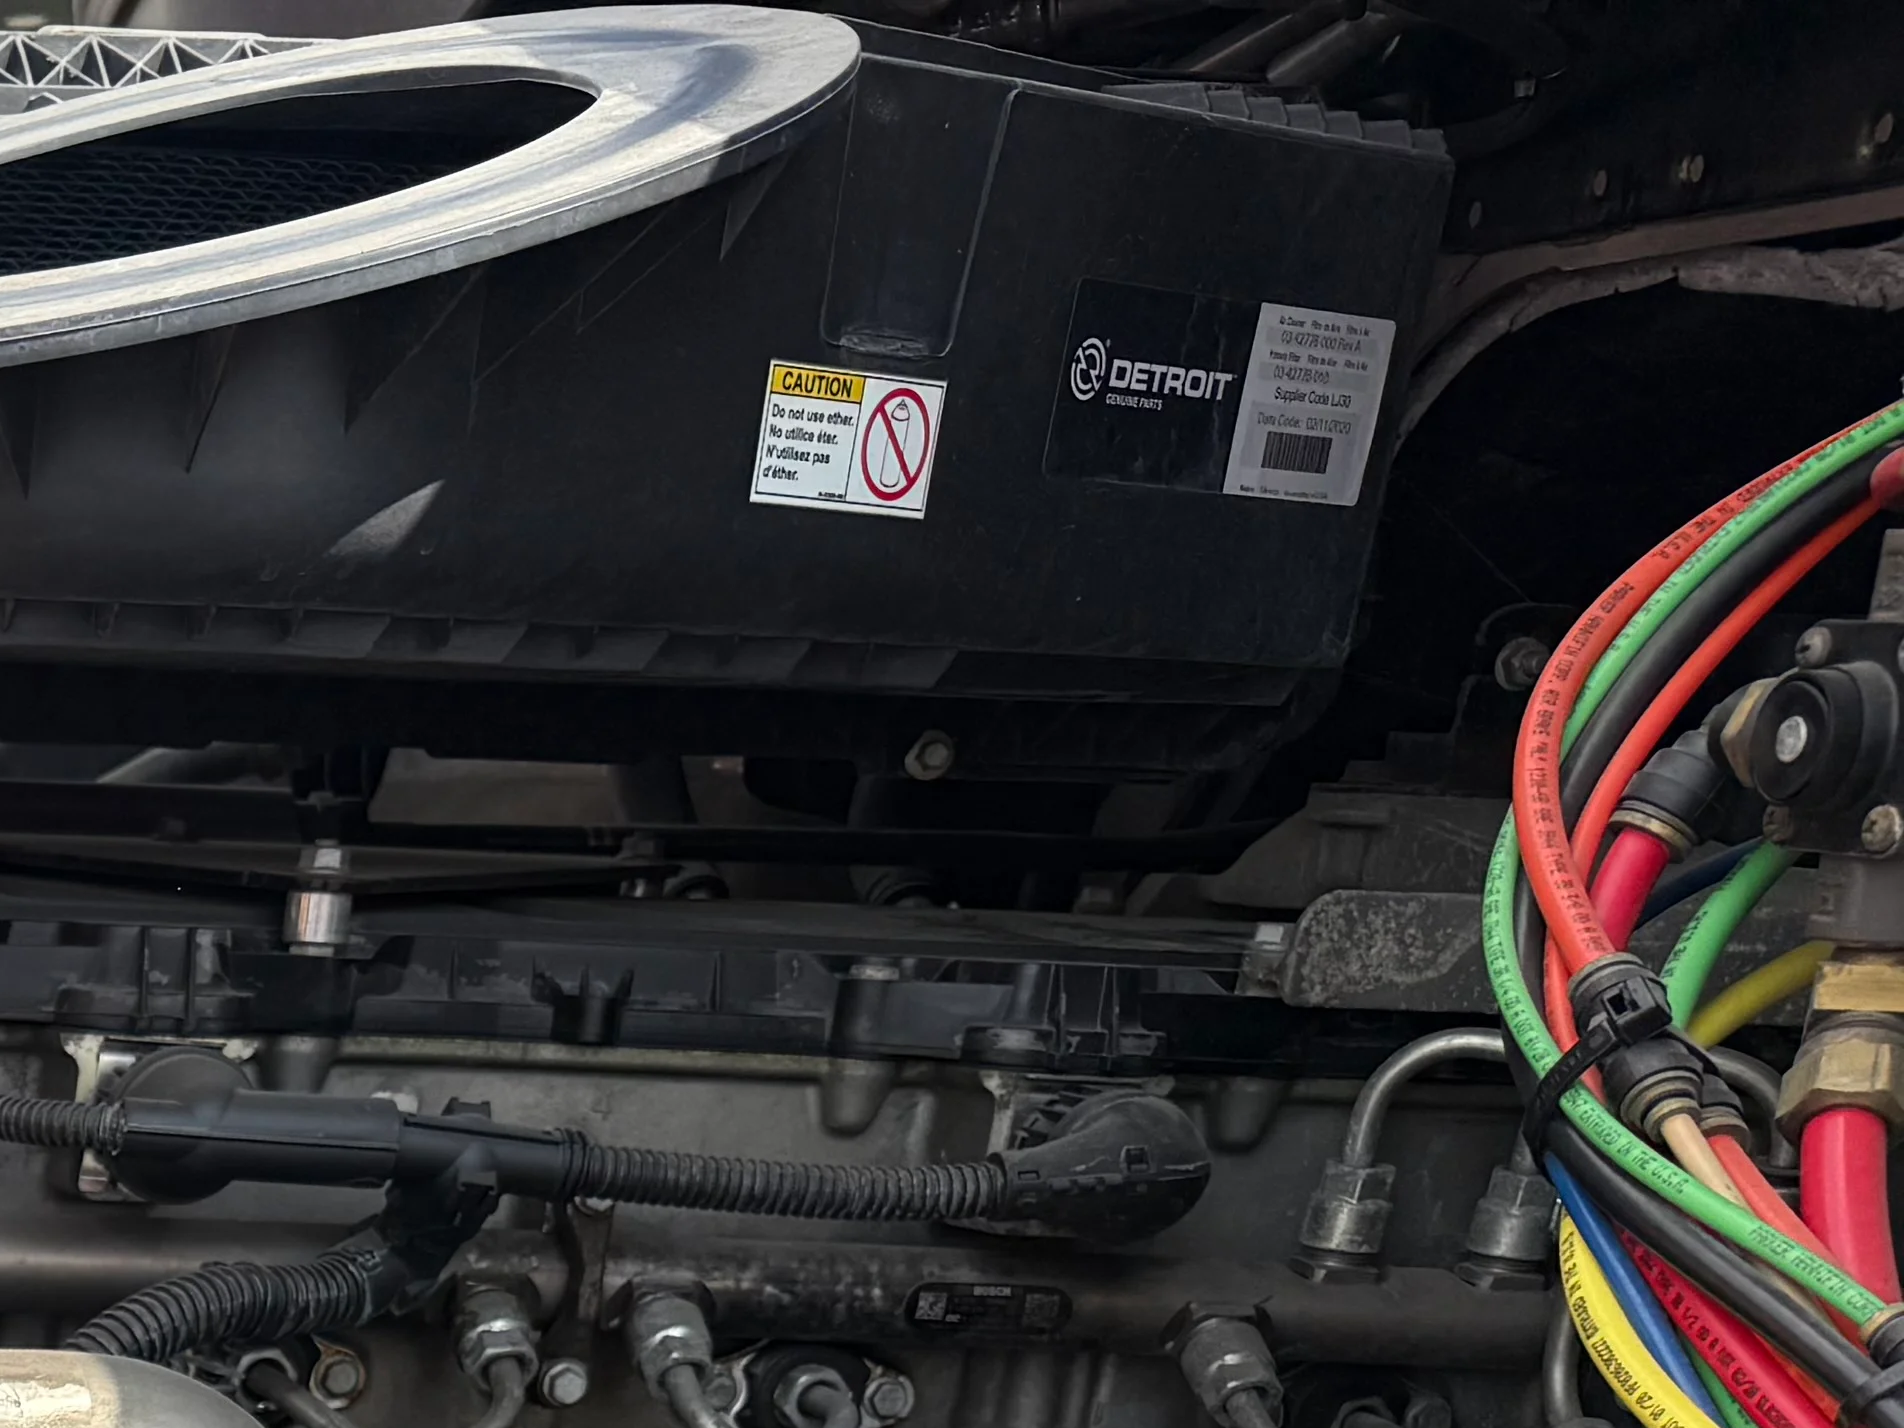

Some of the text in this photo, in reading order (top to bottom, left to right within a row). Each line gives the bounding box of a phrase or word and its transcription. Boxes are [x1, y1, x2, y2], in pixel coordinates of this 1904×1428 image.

[782, 371, 853, 398] CAUTION
[1108, 358, 1233, 401] DETROIT
[772, 403, 854, 427] Do not use ether.
[769, 424, 782, 438] No
[812, 453, 831, 465] pas
